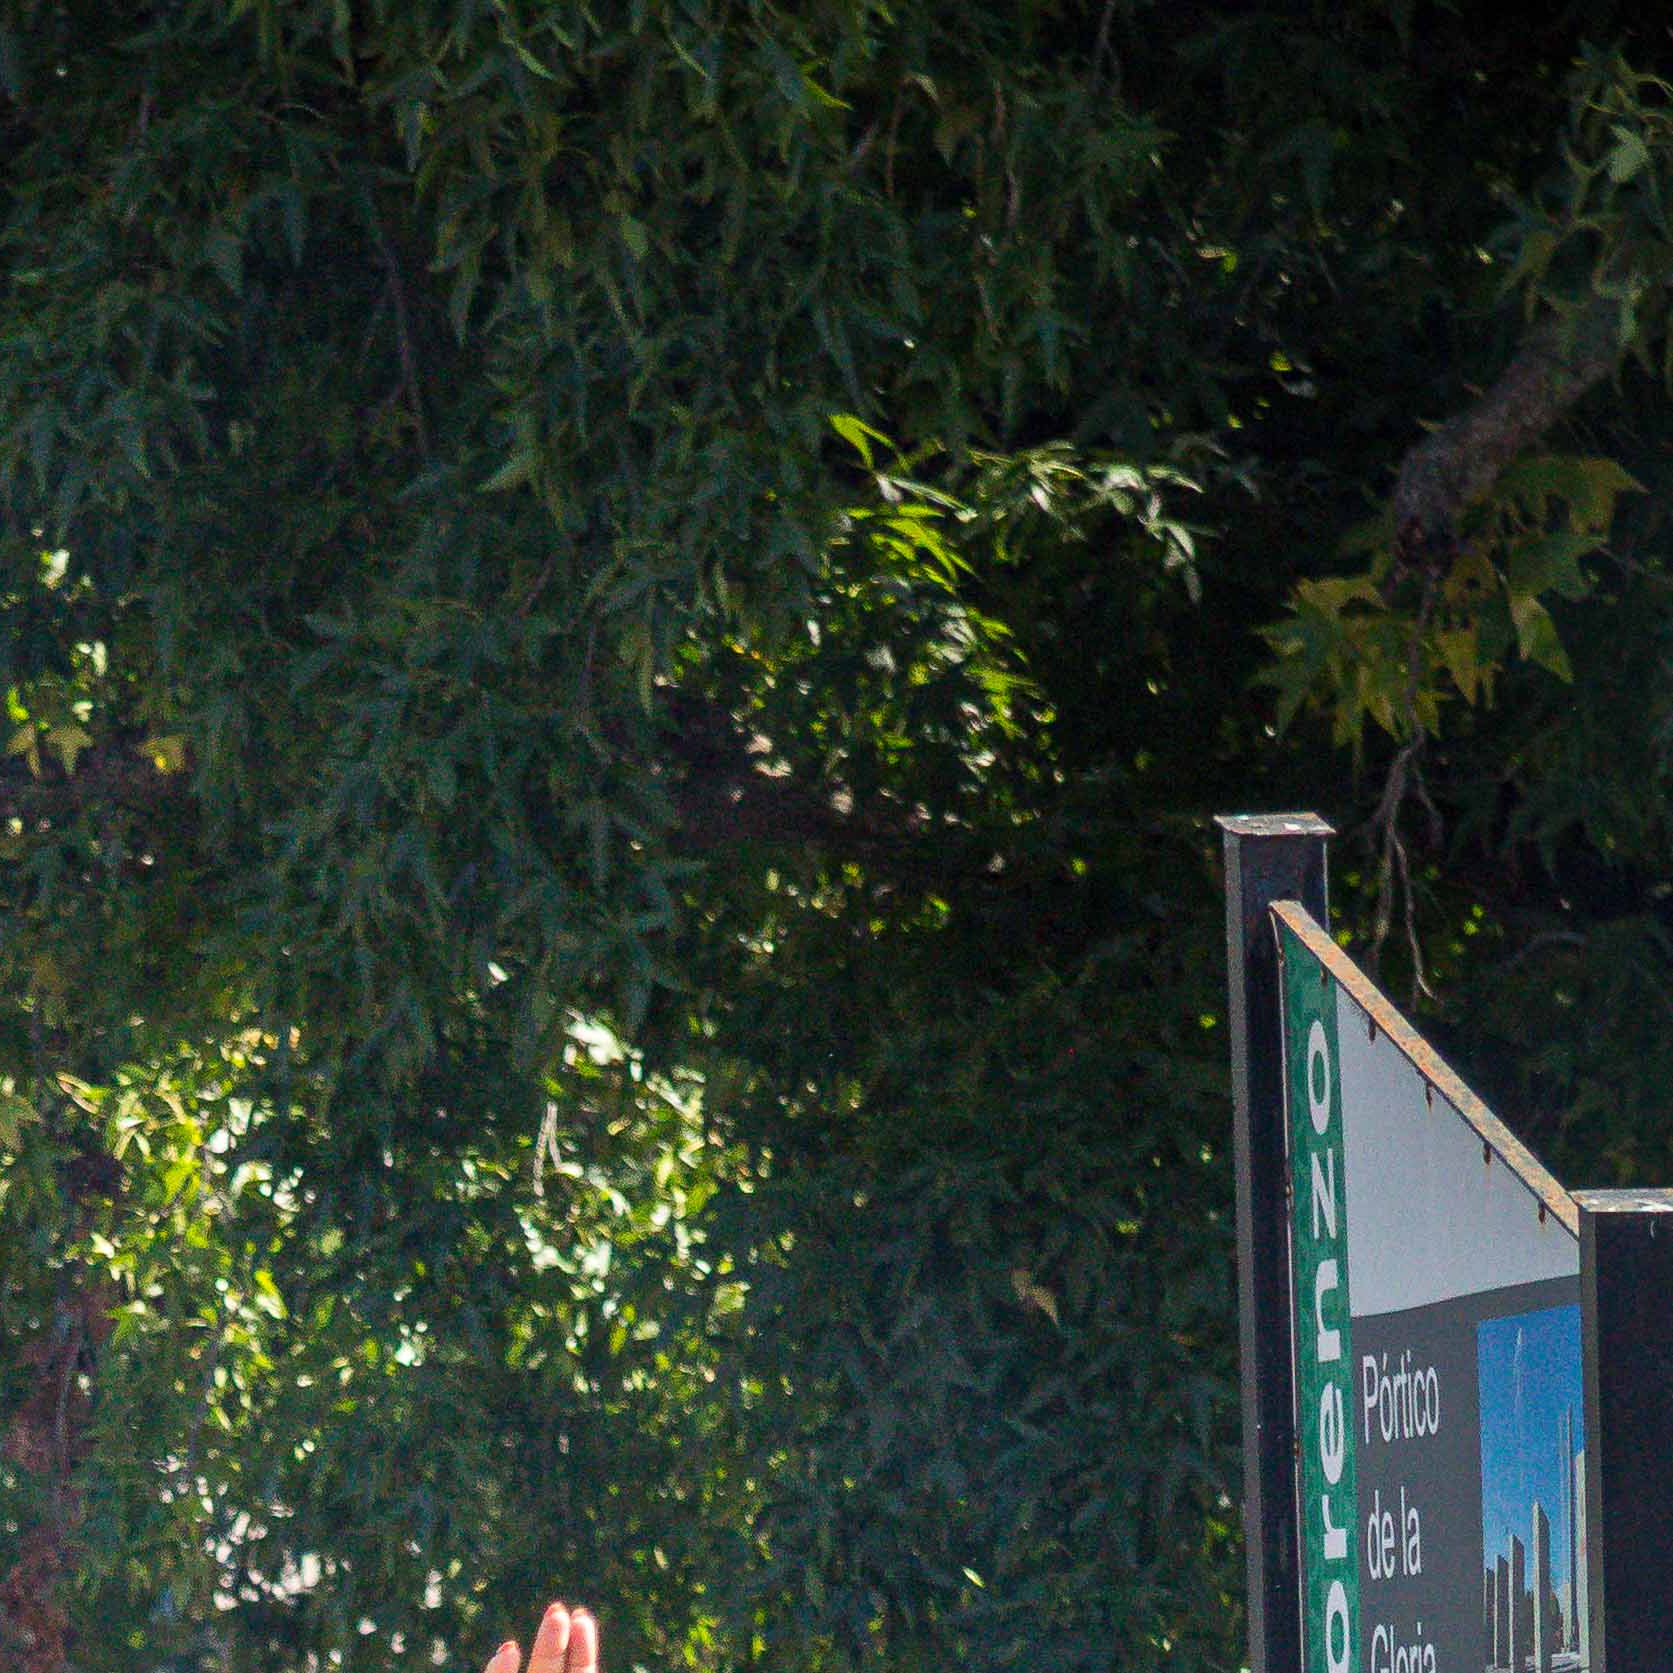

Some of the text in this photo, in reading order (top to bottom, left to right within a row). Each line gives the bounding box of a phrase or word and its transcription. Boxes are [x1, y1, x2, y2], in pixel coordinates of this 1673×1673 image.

[1362, 1350, 1439, 1444] Pórtico
[1367, 1486, 1422, 1580] de la
